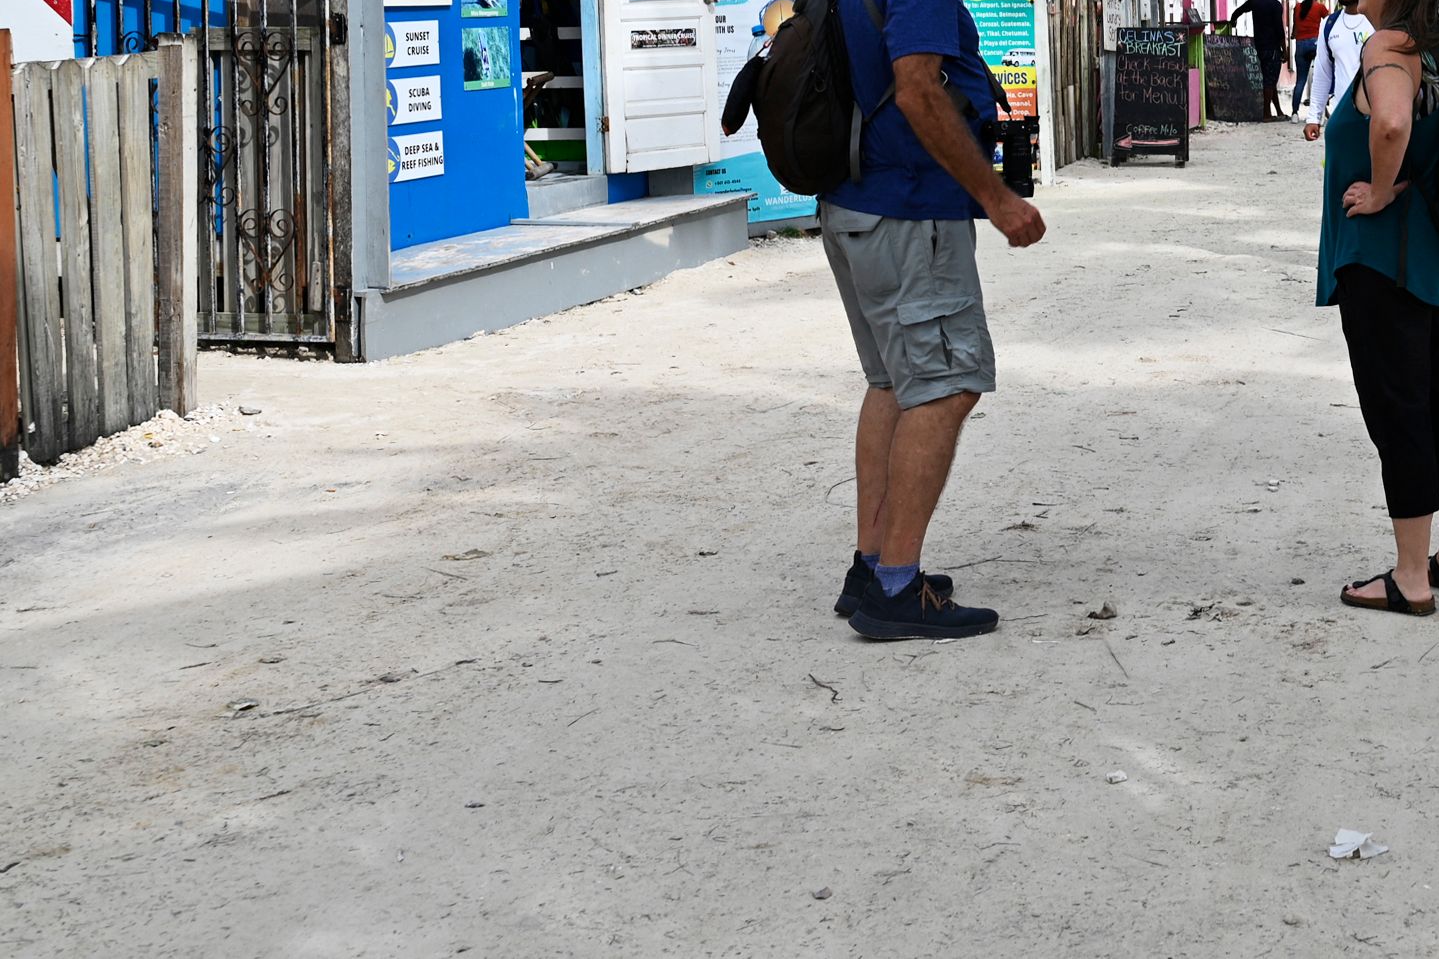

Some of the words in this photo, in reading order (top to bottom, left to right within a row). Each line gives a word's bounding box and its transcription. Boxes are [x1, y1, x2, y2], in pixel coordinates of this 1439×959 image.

[727, 25, 735, 34] US
[405, 31, 430, 42] SUNSET
[407, 44, 429, 56] CRUISE
[1124, 41, 1185, 57] BREAKFAST
[993, 70, 1028, 85] vices
[408, 87, 430, 98] SCUBA
[408, 100, 431, 112] DIVING
[404, 145, 420, 156] DEEP
[422, 144, 433, 153] SEA
[435, 143, 439, 151] &
[401, 159, 417, 170] REEF
[418, 154, 444, 168] FISHING
